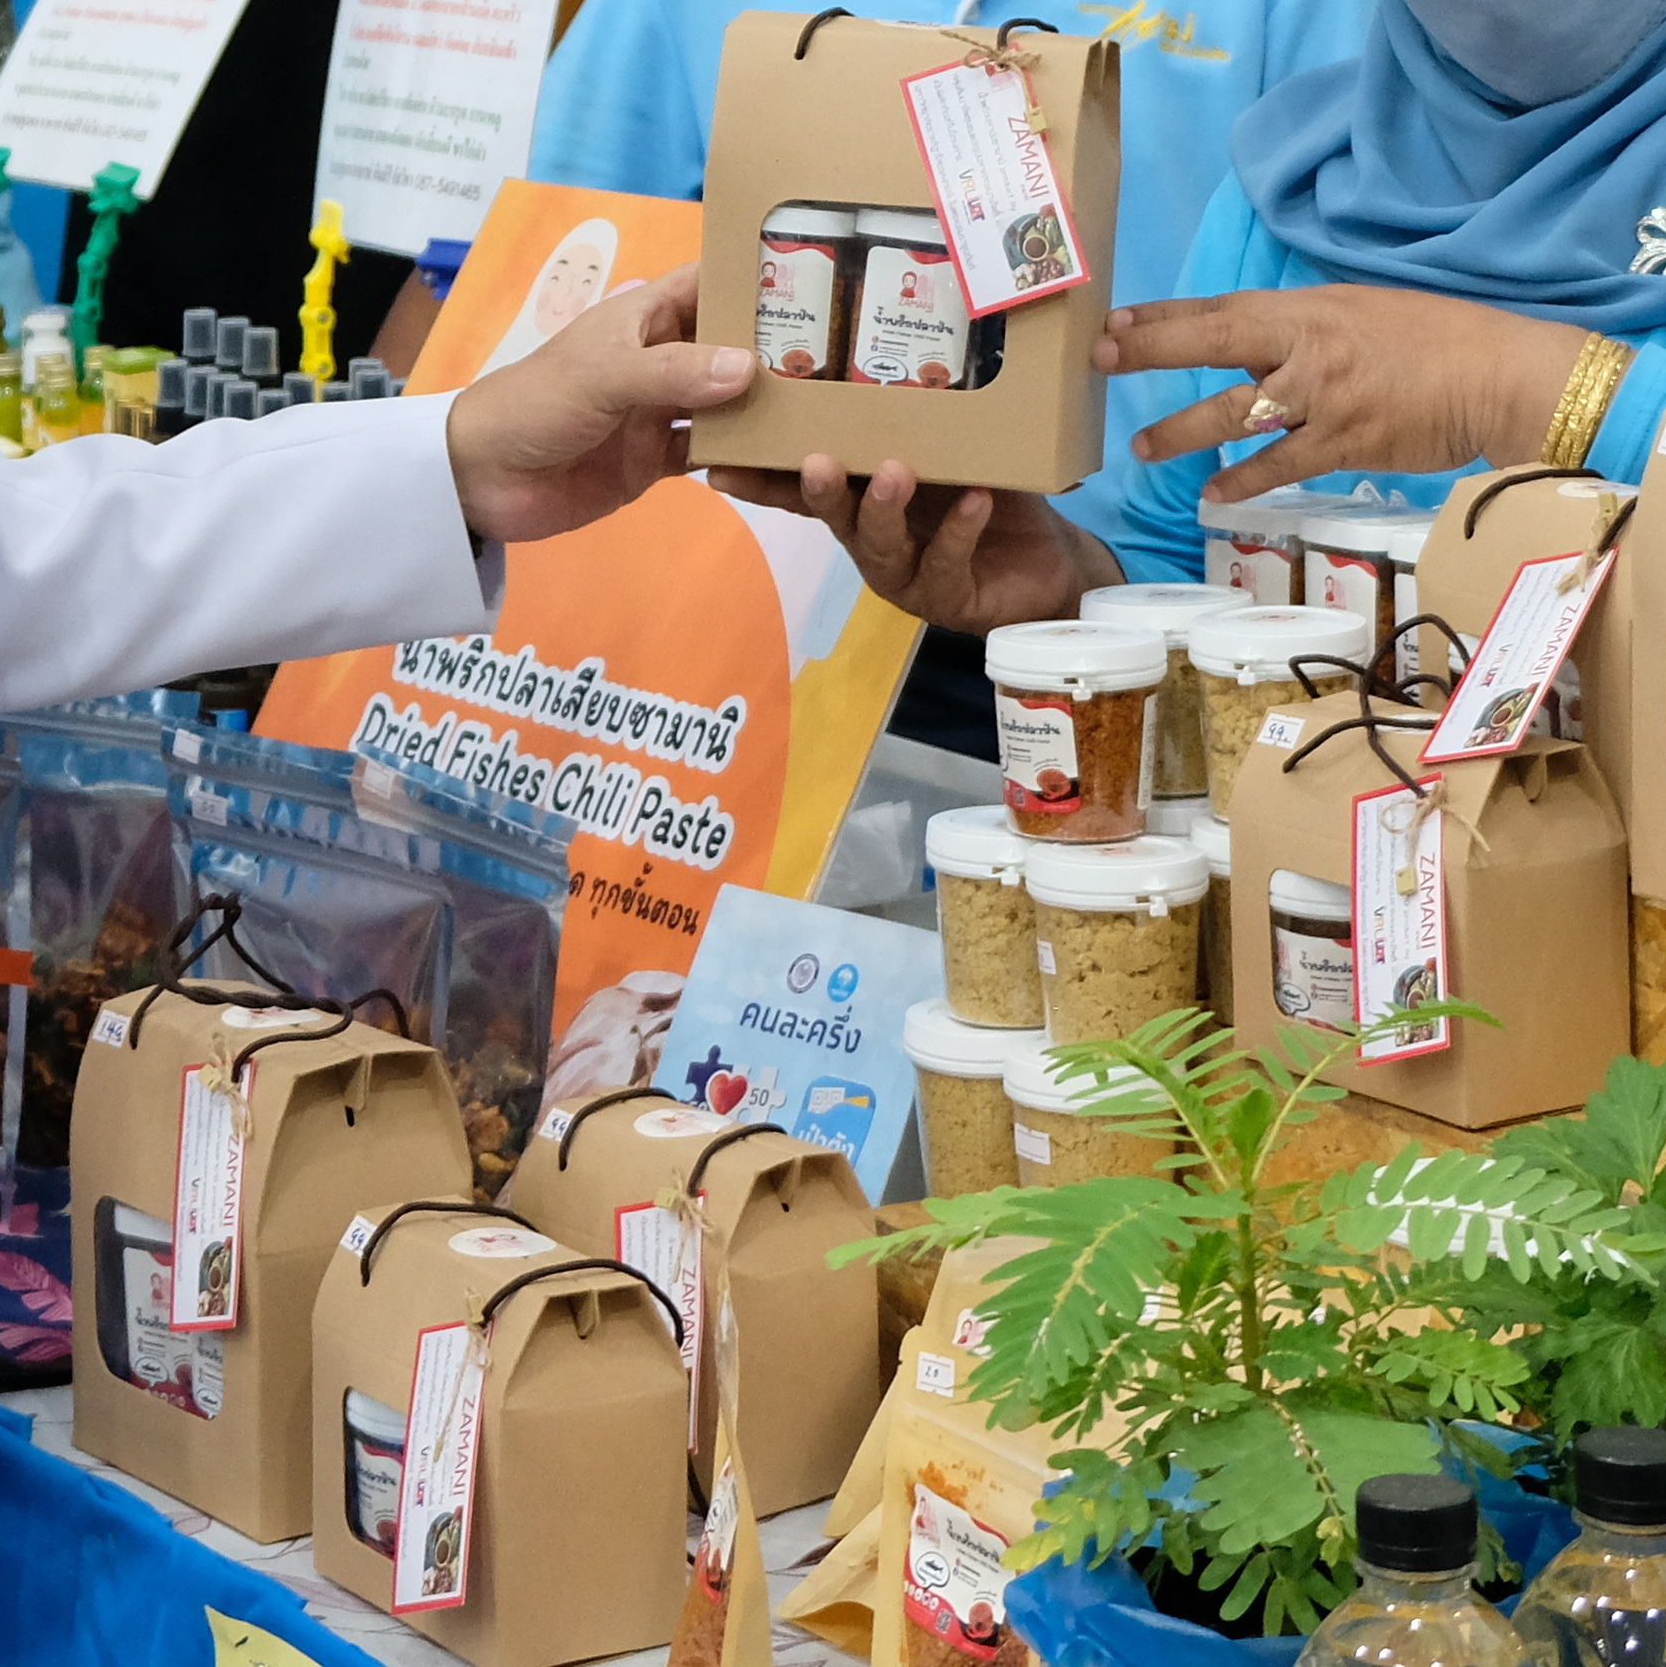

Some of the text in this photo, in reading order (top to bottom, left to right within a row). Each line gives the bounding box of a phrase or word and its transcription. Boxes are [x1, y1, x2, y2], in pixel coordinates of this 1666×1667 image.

[1007, 111, 1051, 200] ZAMANI
[1530, 602, 1582, 677] ZAMANI
[446, 731, 547, 804] Fishes
[551, 762, 635, 830] Chili
[630, 786, 728, 859] Paste
[591, 862, 700, 936] ทุกขั้นตอน
[1419, 851, 1437, 950] ZAMANI
[739, 1001, 863, 1054] คนละครึ่ง
[748, 1088, 770, 1107] 50
[222, 1133, 242, 1228] ZAMANI
[681, 1265, 697, 1360] ZAMANI
[453, 1394, 477, 1497] ZAMANI
